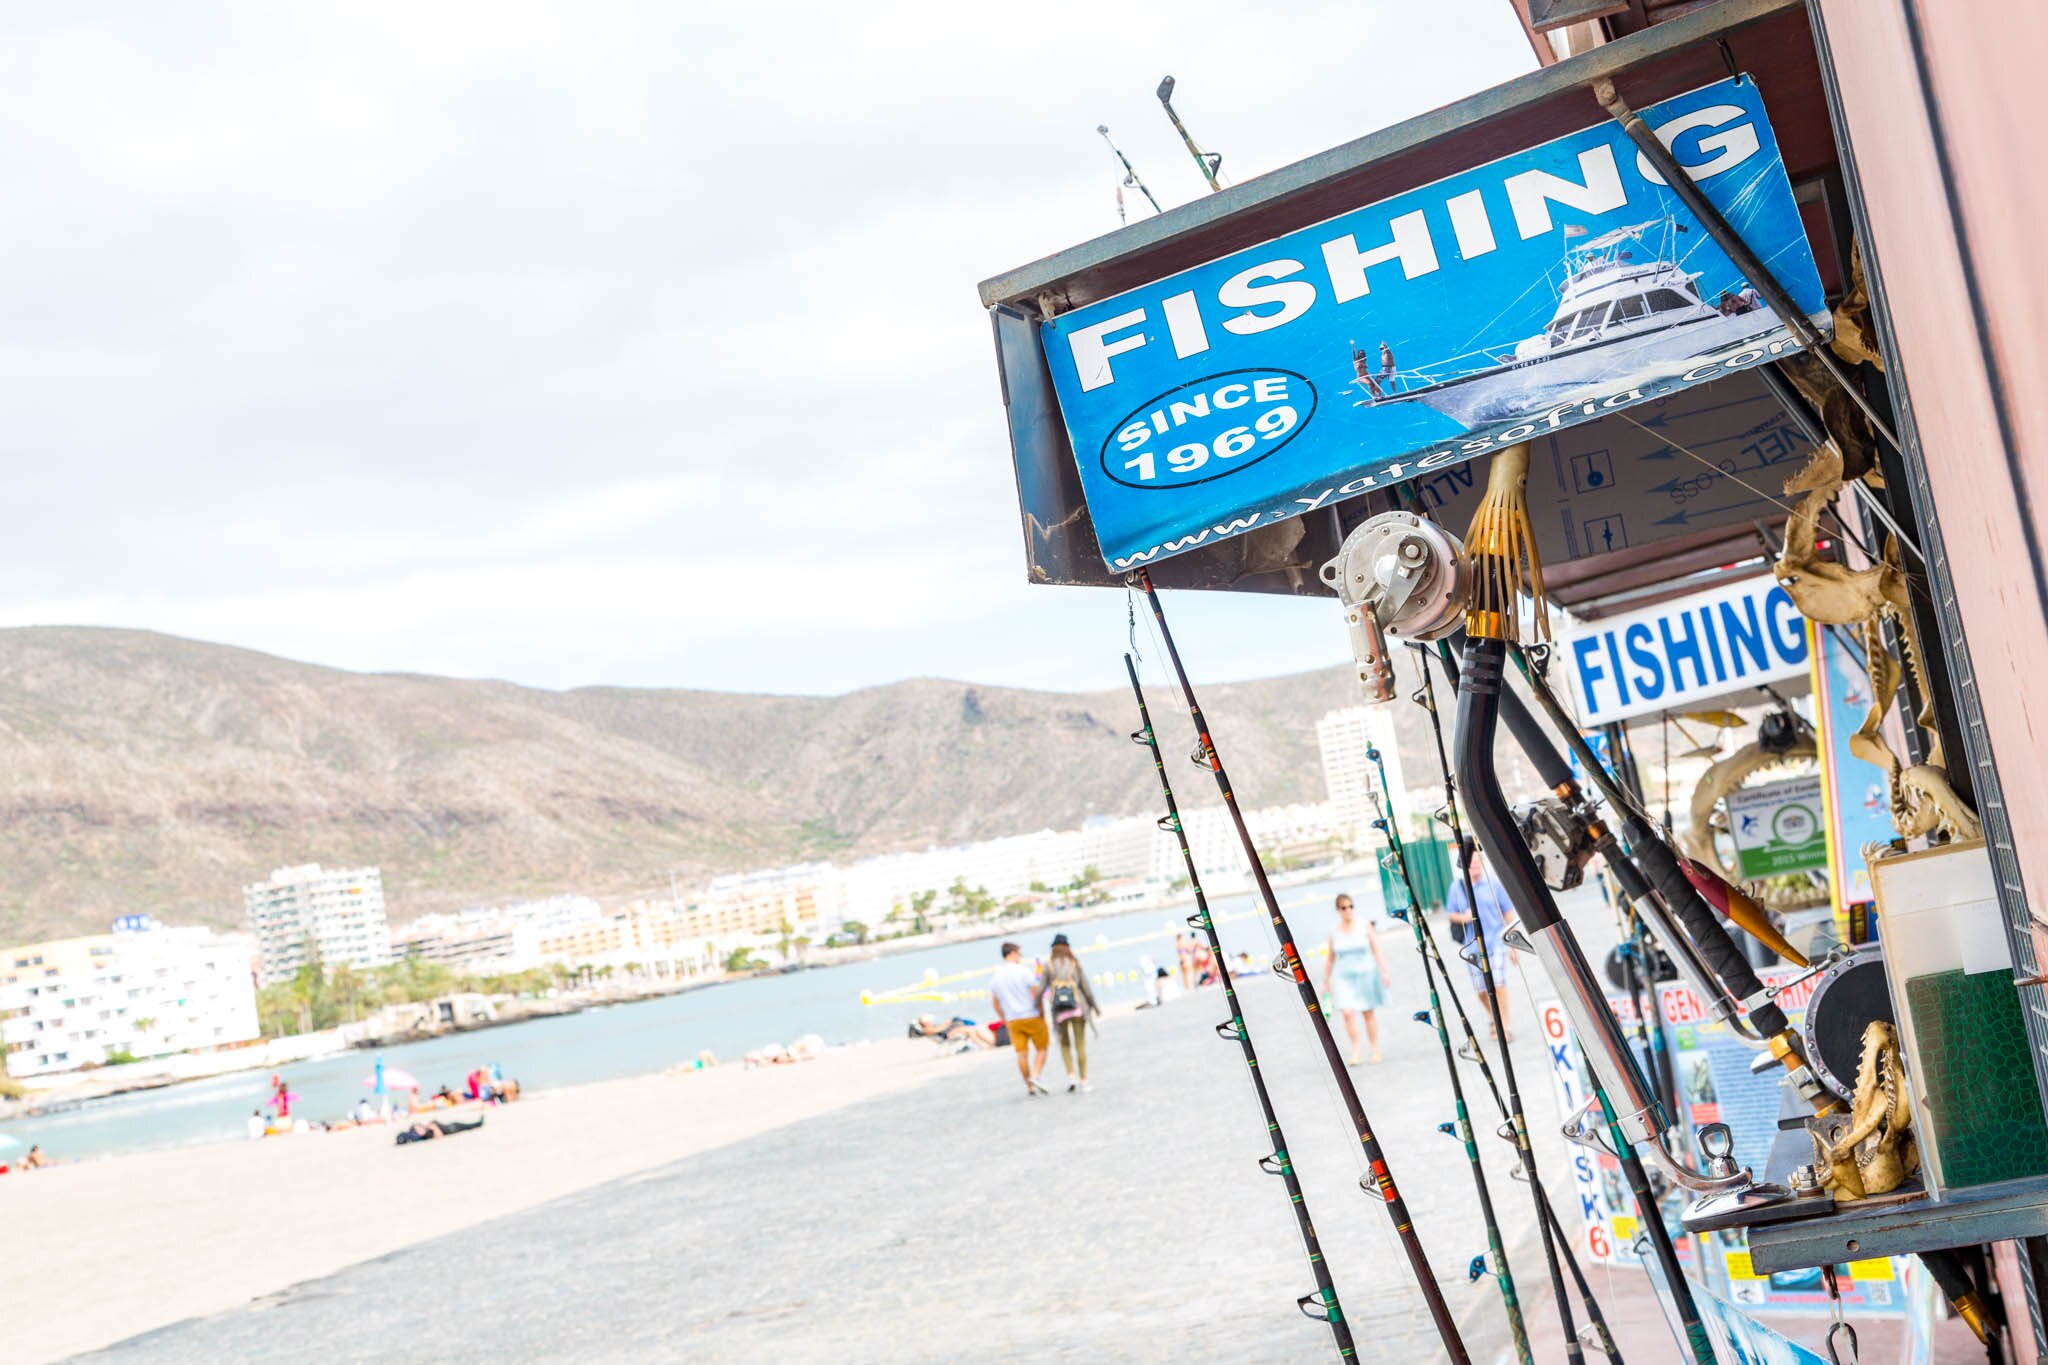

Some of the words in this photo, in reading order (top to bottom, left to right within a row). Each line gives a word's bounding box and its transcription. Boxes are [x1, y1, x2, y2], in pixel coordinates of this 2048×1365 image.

[1066, 104, 1761, 393] FISHING
[1117, 377, 1289, 451] SINCE
[1124, 405, 1298, 481] 1969
[1571, 585, 1809, 715] FISHING
[1544, 1007, 1565, 1039] 6
